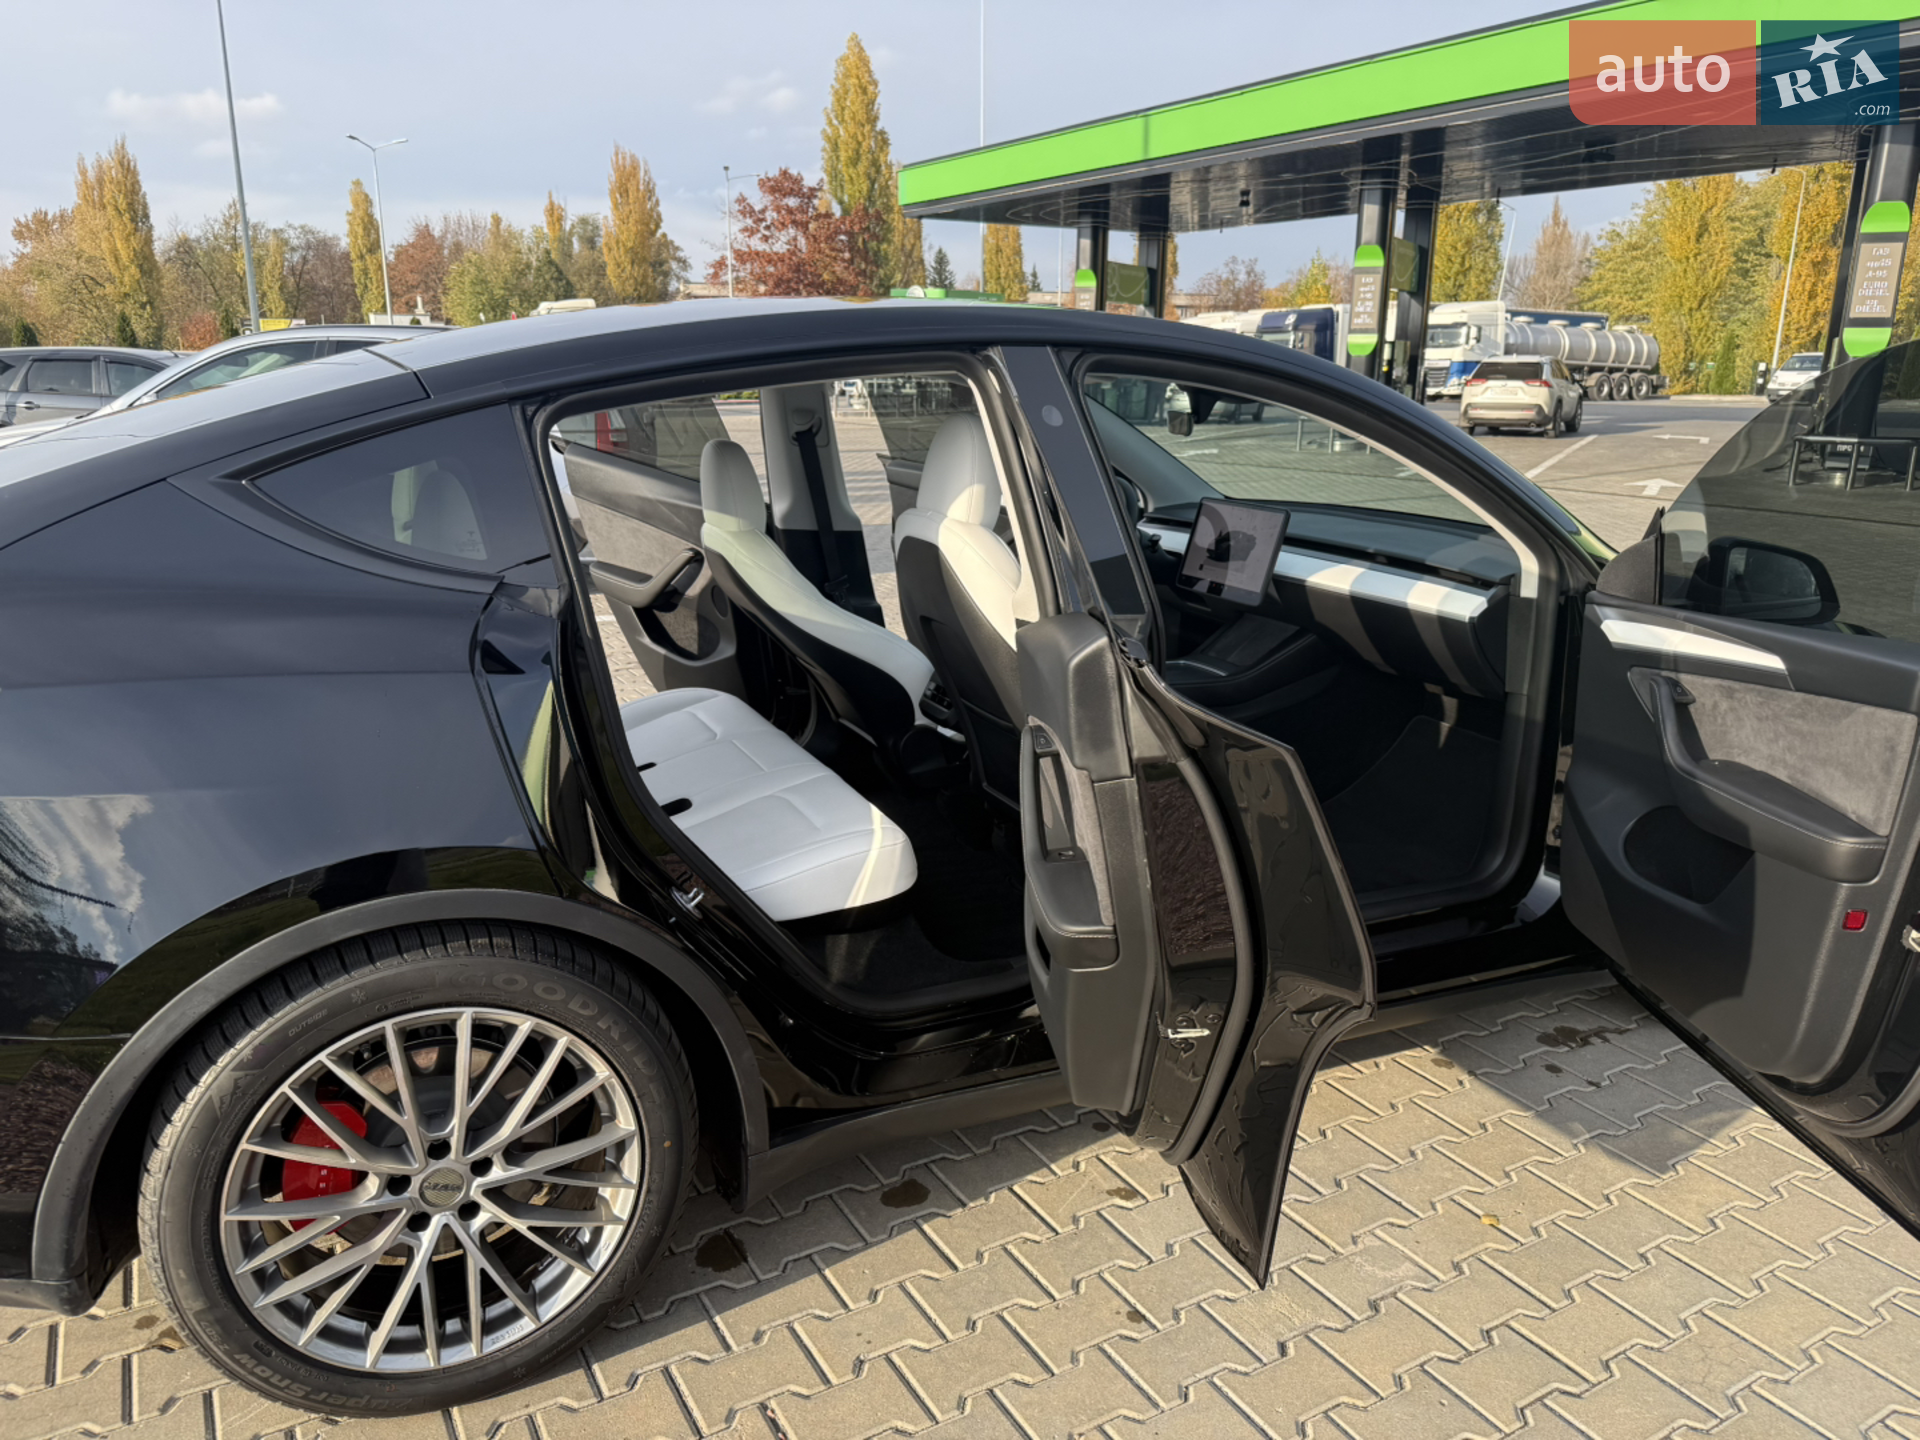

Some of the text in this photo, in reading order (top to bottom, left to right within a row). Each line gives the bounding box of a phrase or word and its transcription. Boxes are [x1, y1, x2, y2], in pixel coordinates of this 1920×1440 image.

[288, 1008, 329, 1038] OUTSIDE
[457, 970, 667, 1106] GOODRIDE
[200, 1320, 230, 1352] Z-507
